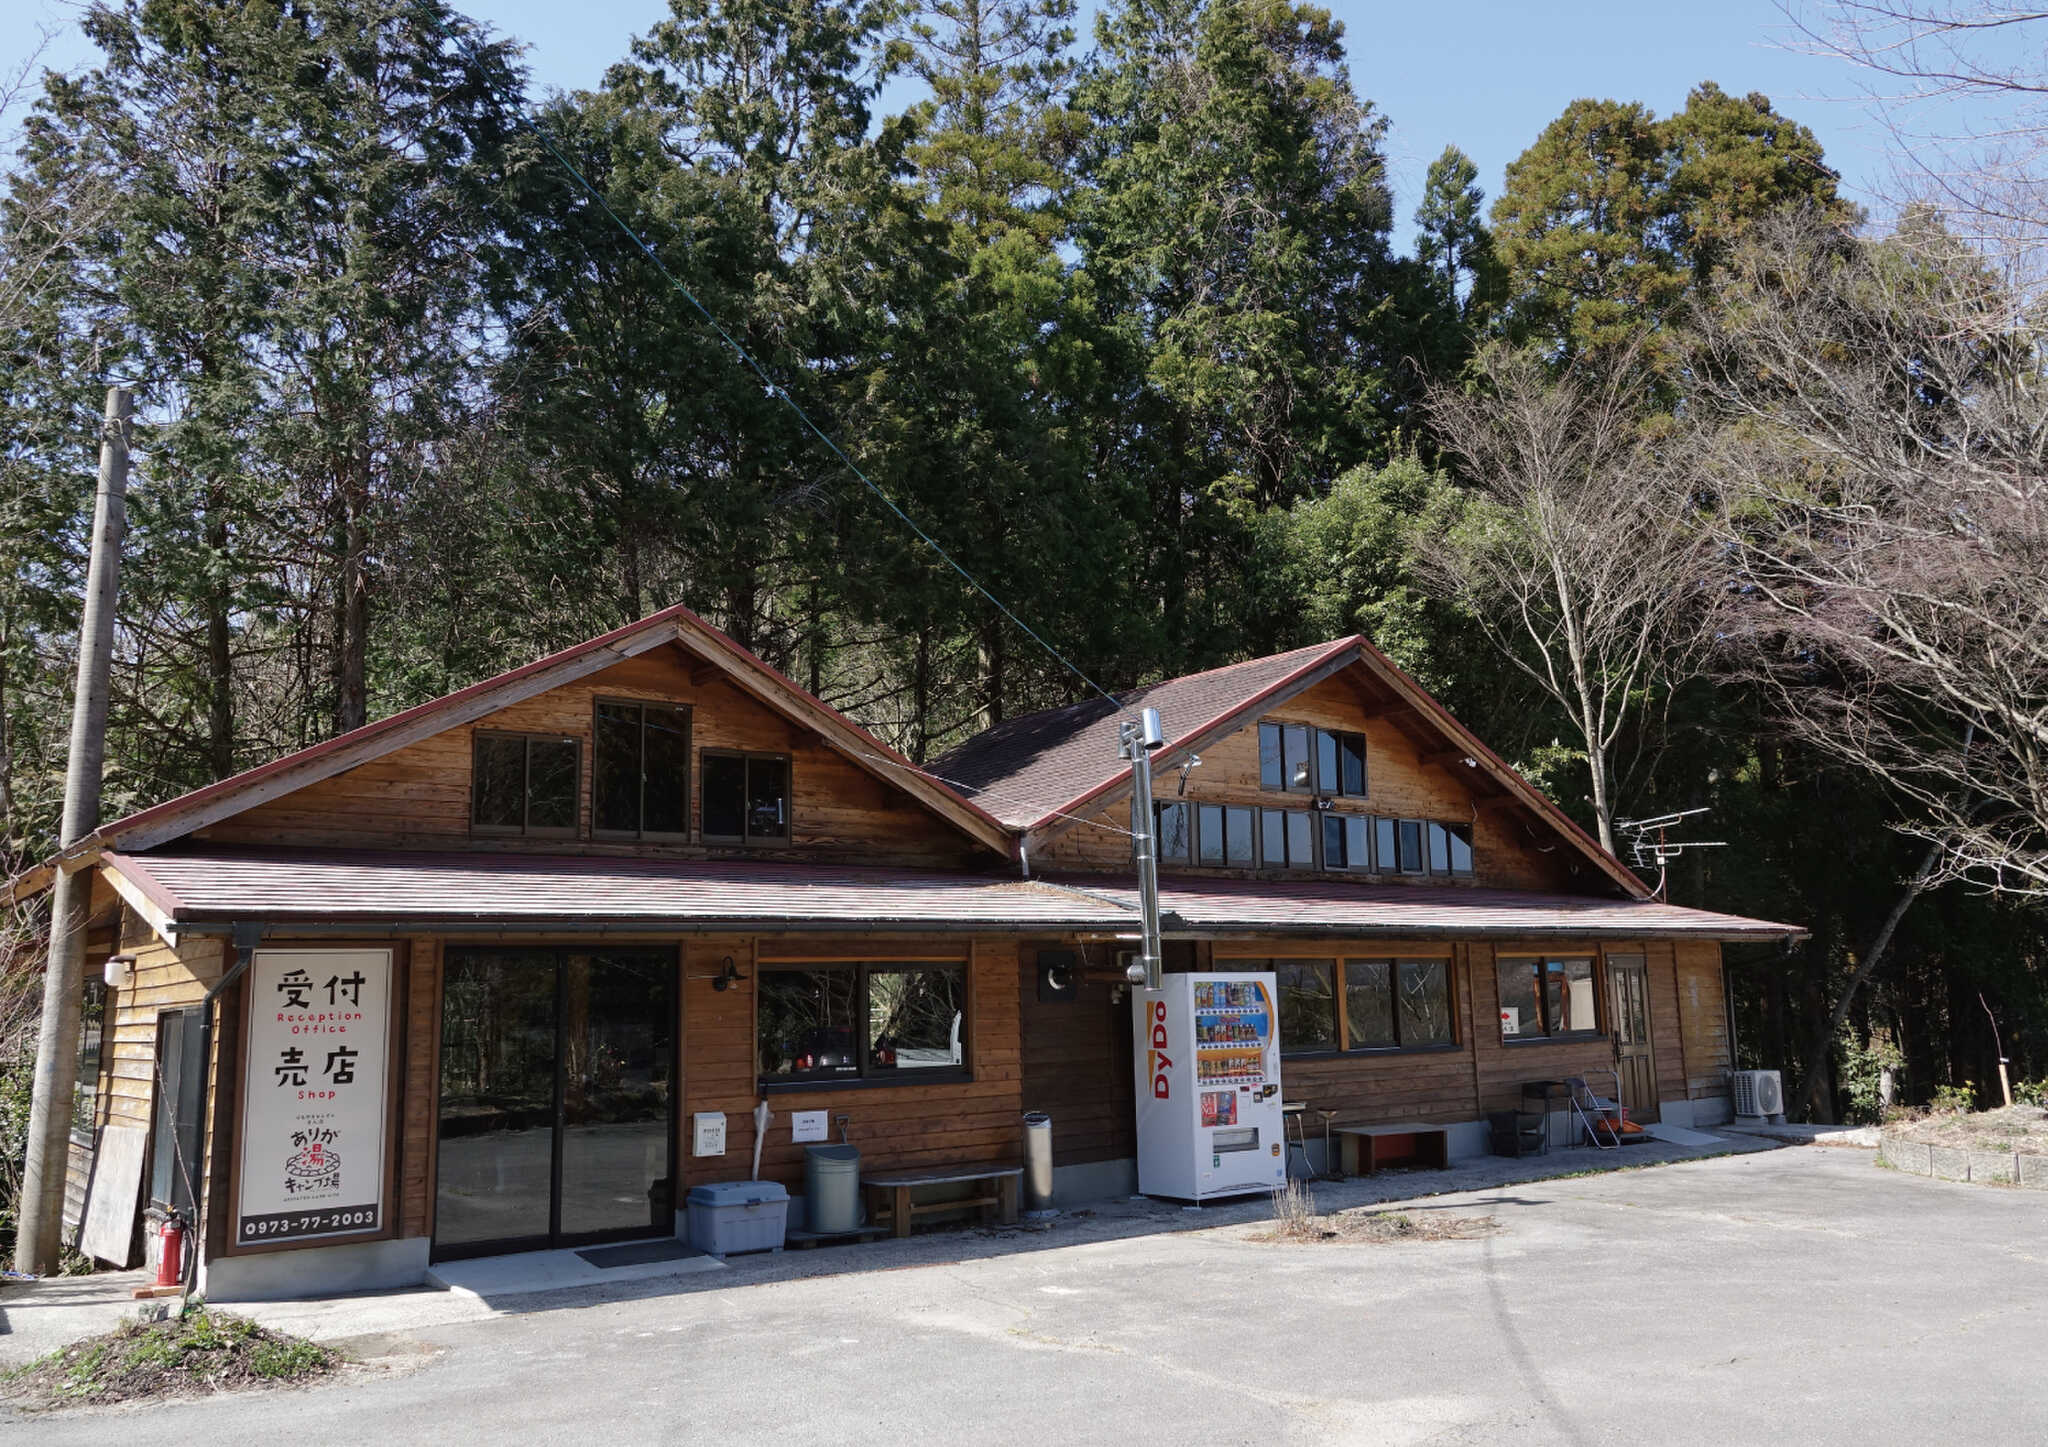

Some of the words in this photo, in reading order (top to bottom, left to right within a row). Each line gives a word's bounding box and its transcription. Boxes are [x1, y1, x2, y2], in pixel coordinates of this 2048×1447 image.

[277, 968, 366, 1009] 受付
[277, 1011, 362, 1023] Reception
[292, 1023, 347, 1034] Office
[1153, 1000, 1174, 1100] DyDo
[275, 1045, 359, 1087] 売店
[297, 1089, 337, 1101] Shop
[245, 1211, 374, 1236] 0973-77-2003
